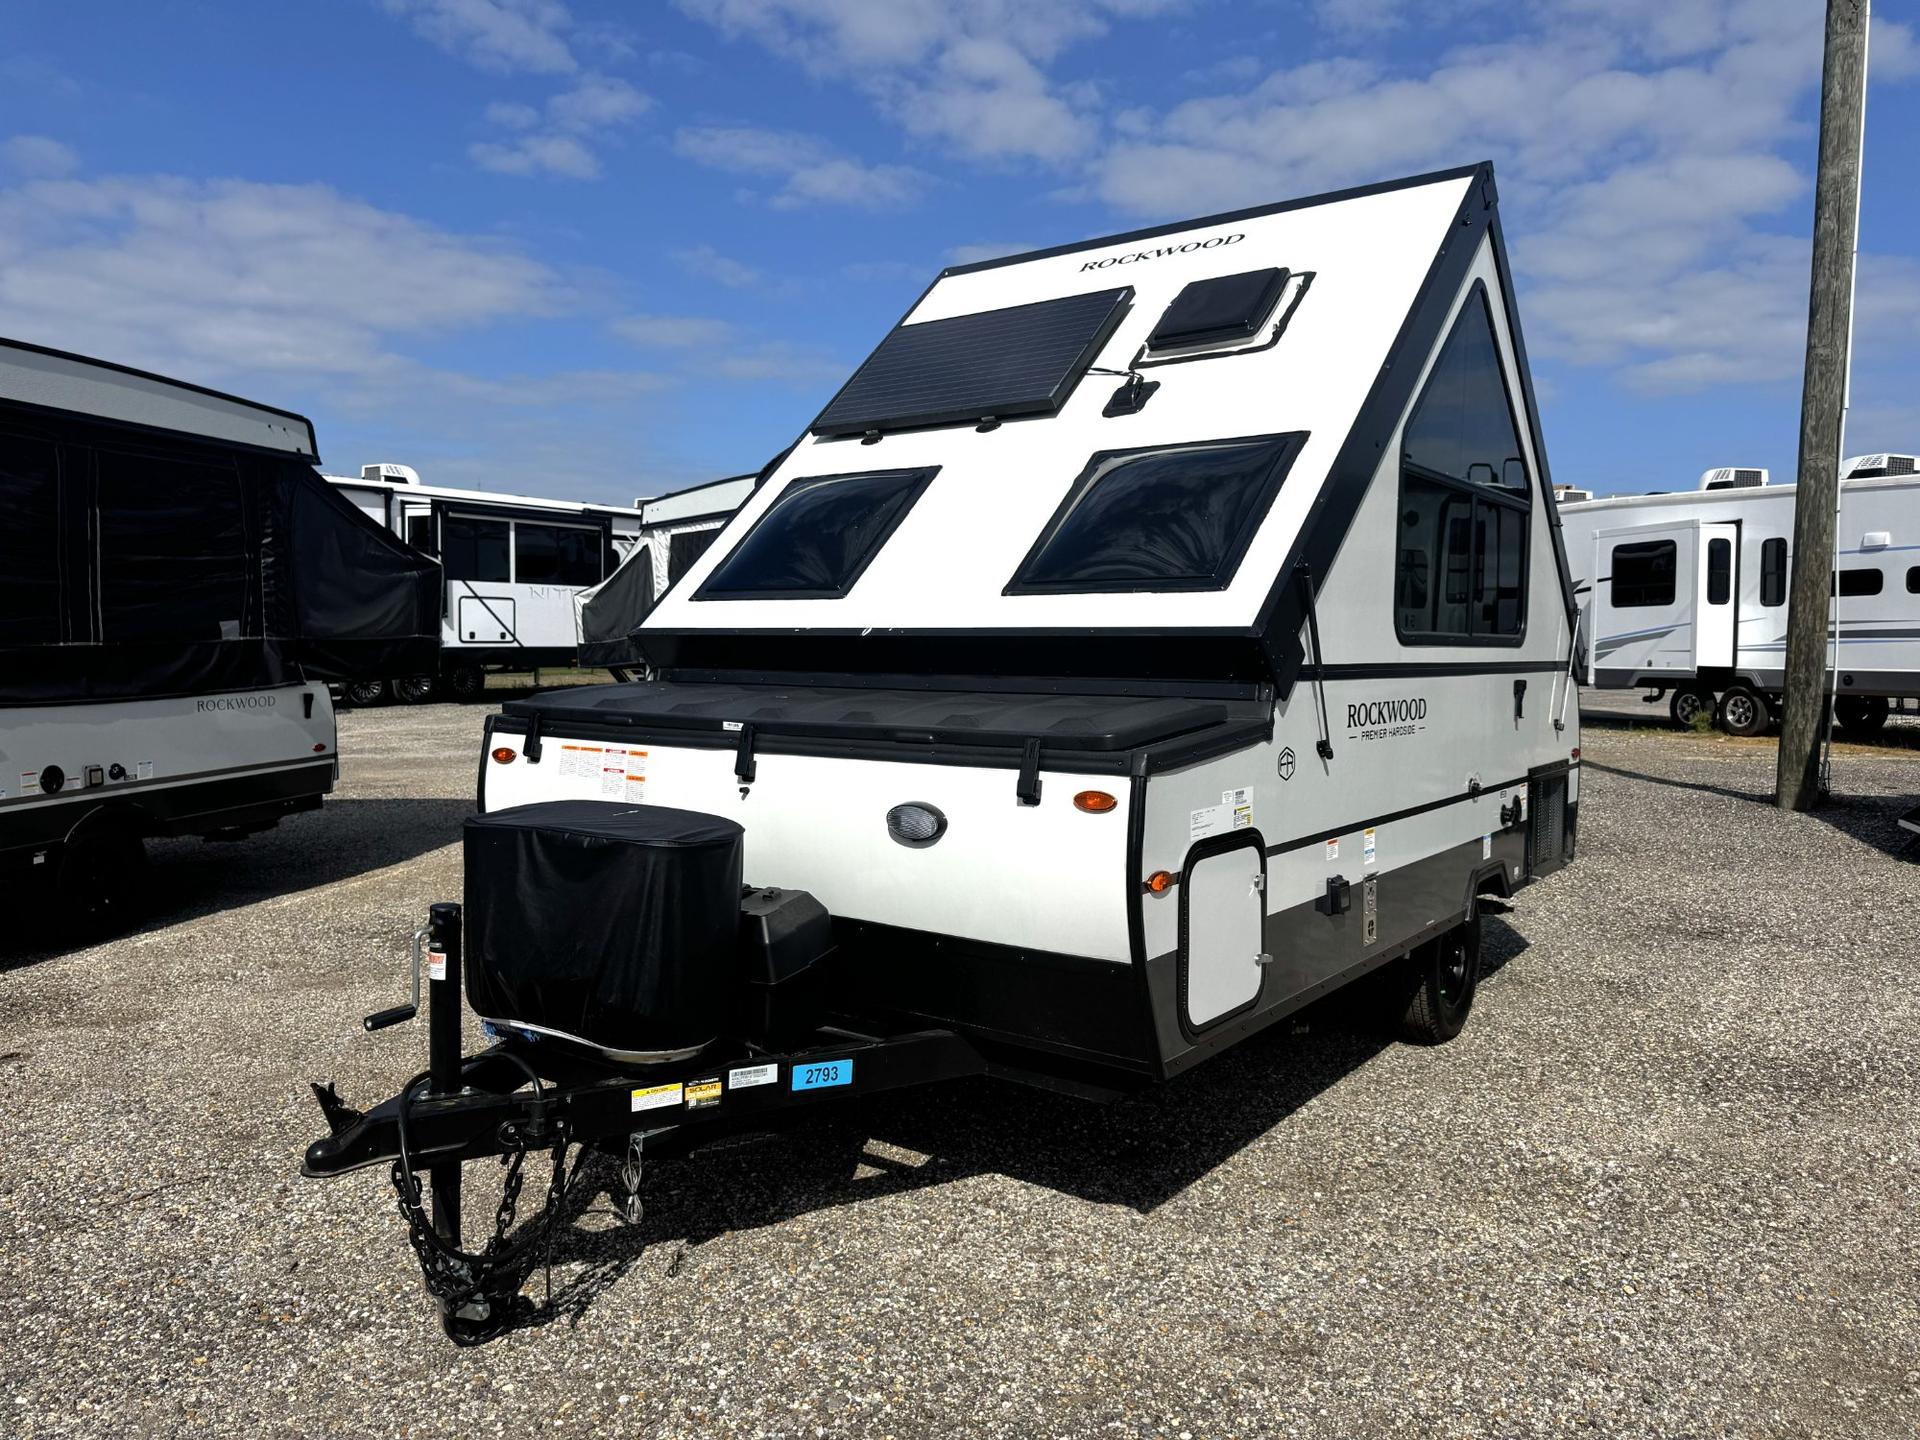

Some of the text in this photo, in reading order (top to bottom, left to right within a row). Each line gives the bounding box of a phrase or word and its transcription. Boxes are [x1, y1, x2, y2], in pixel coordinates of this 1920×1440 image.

[1079, 234, 1246, 272] ROCKWOOD
[197, 695, 276, 713] ROCKWOOD
[1347, 698, 1427, 728] ROCKWOOD
[1361, 725, 1416, 741] PREMIER HARDSIDE
[805, 1066, 839, 1085] 2793
[689, 1084, 717, 1094] SOLAR
